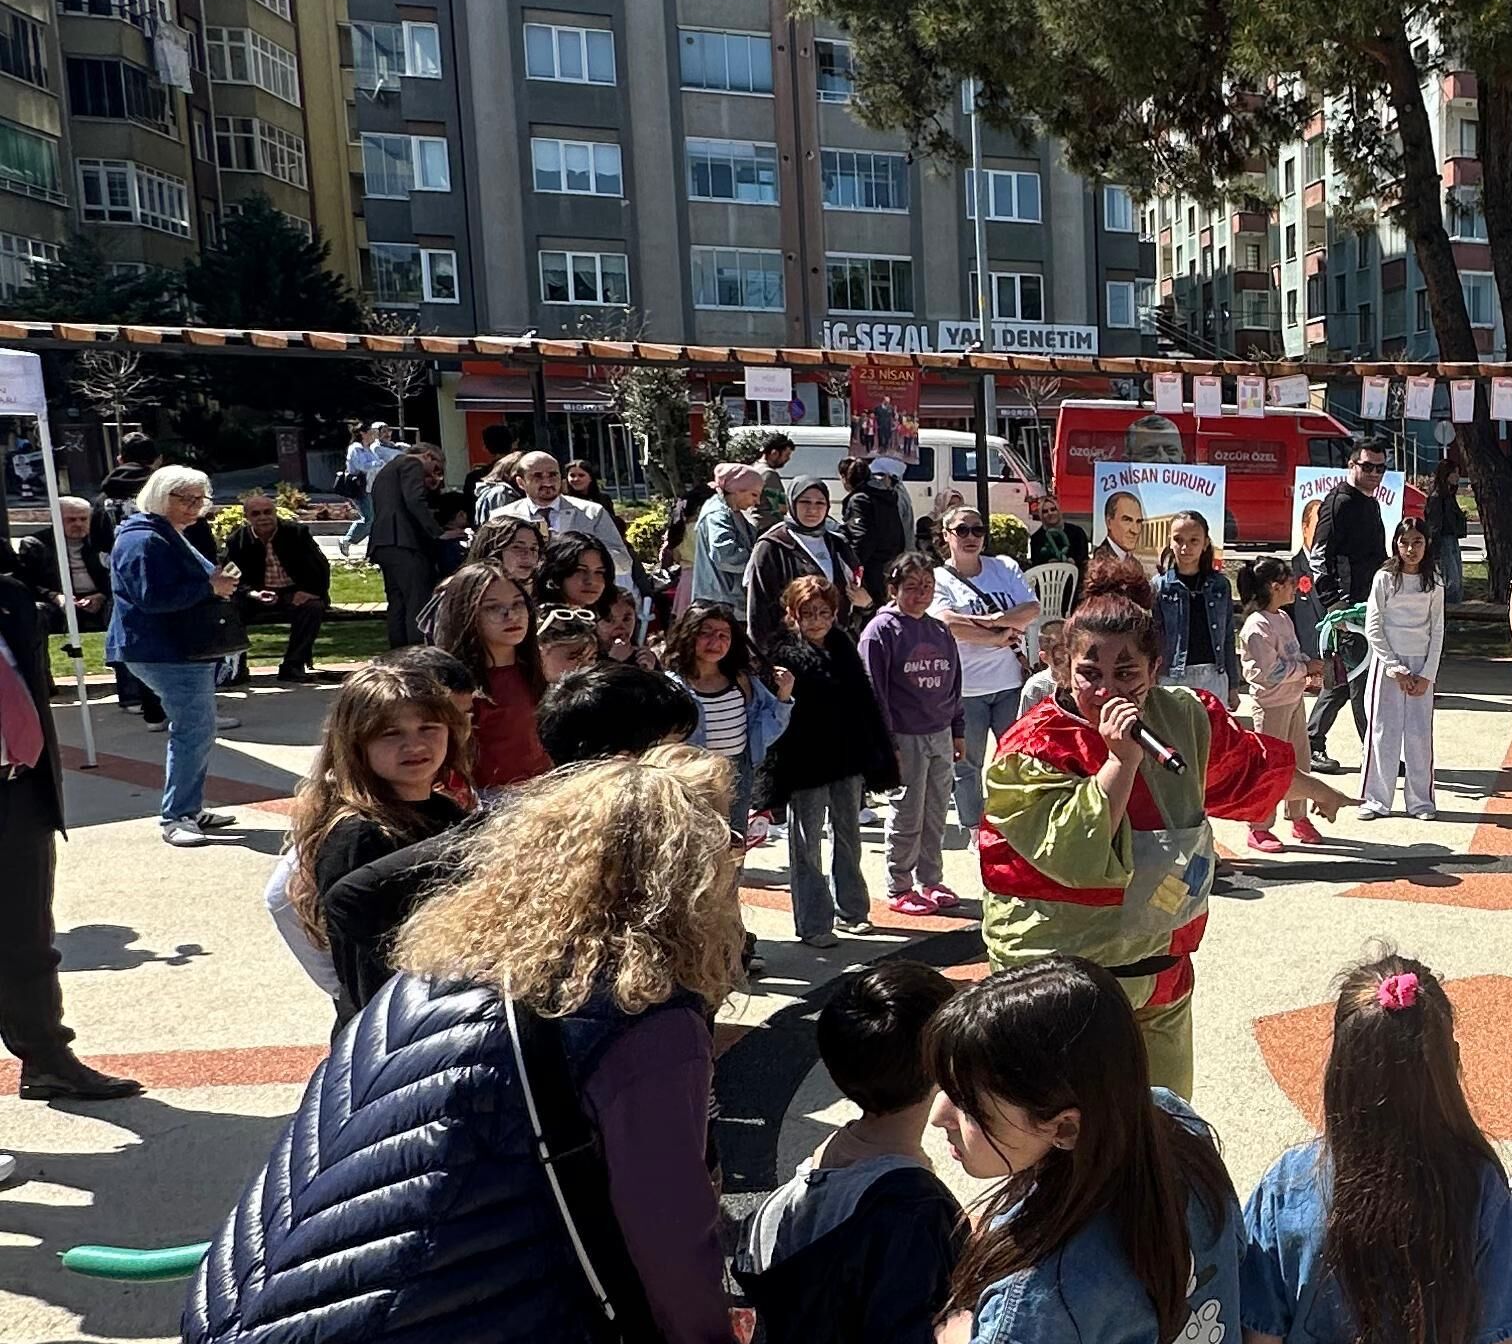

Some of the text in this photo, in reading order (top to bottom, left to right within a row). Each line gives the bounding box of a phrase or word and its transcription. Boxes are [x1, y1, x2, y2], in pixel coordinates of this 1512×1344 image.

[860, 367, 914, 381] 23 NİSAN
[1214, 450, 1277, 462] ÖZGÜR ÖZEL
[1100, 466, 1217, 497] 23 NİSAN GURURU
[1300, 481, 1314, 500] 23
[903, 659, 931, 674] ONLY
[918, 676, 941, 689] YOU
